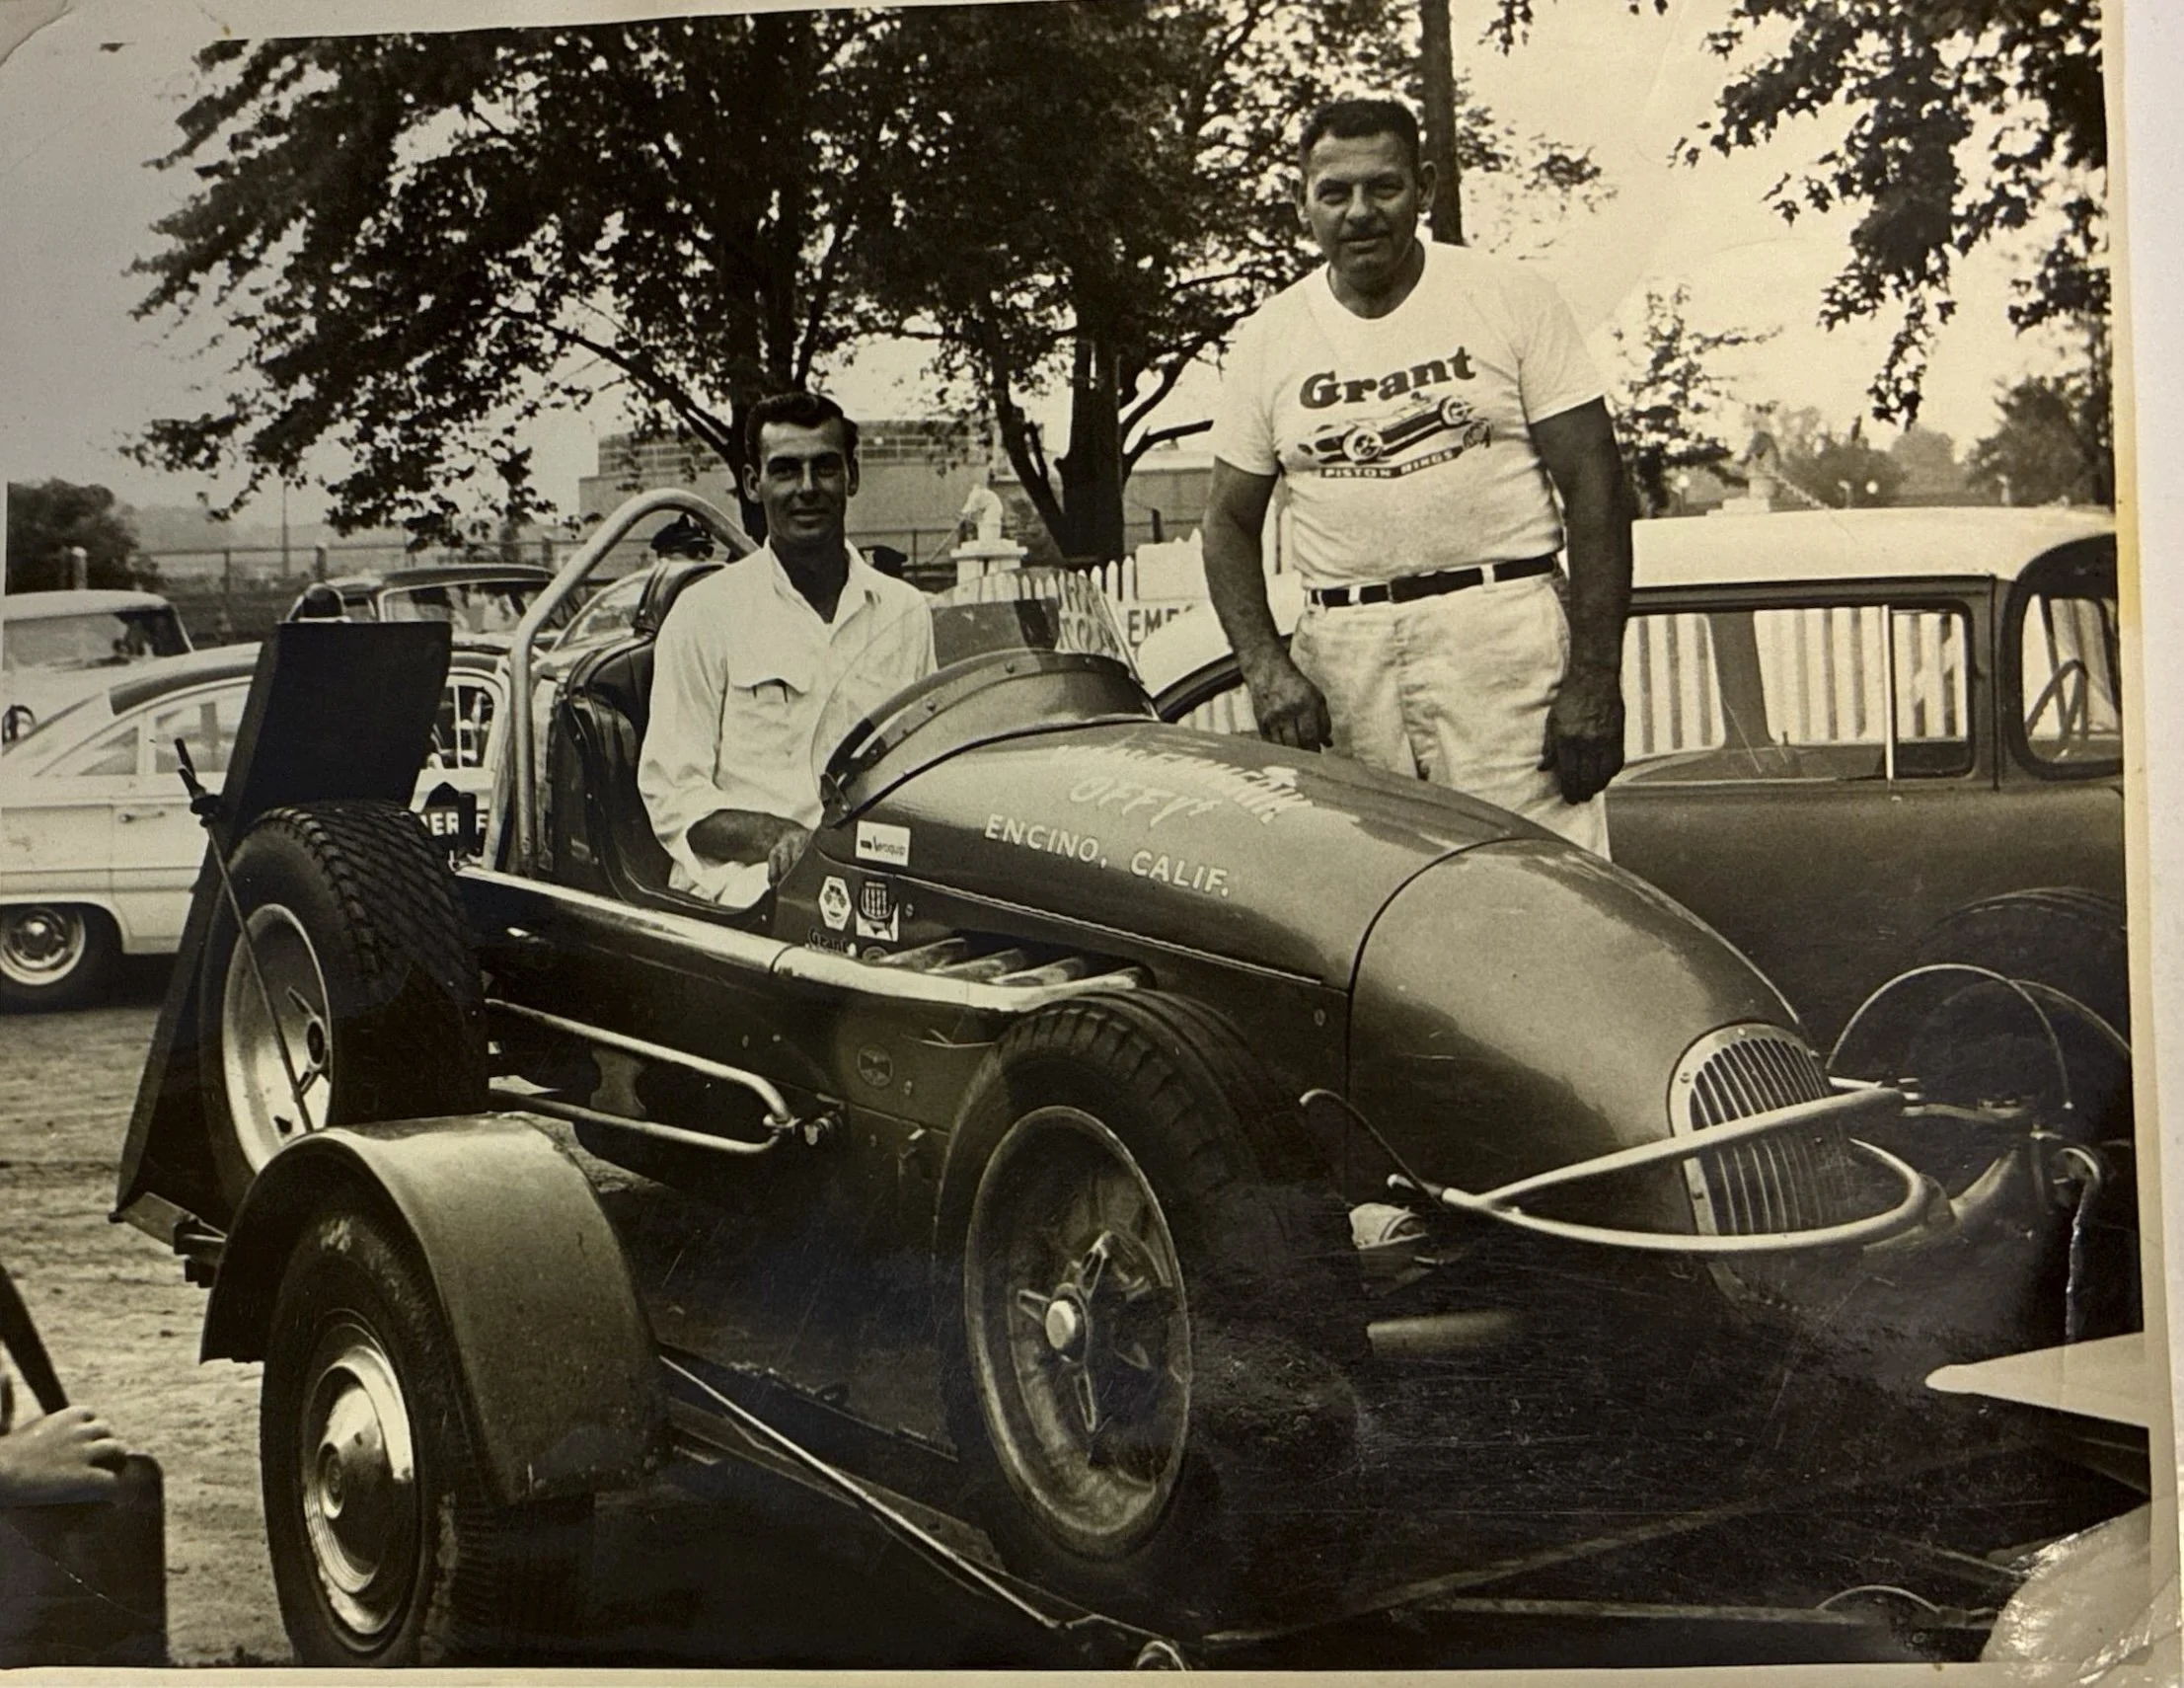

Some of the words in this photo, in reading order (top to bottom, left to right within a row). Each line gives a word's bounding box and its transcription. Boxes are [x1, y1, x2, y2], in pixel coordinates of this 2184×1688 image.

[1299, 345, 1476, 410] Grant
[1325, 467, 1392, 478] PISTON
[985, 813, 1108, 869] ENCINO,
[1130, 850, 1230, 898] CALIF.
